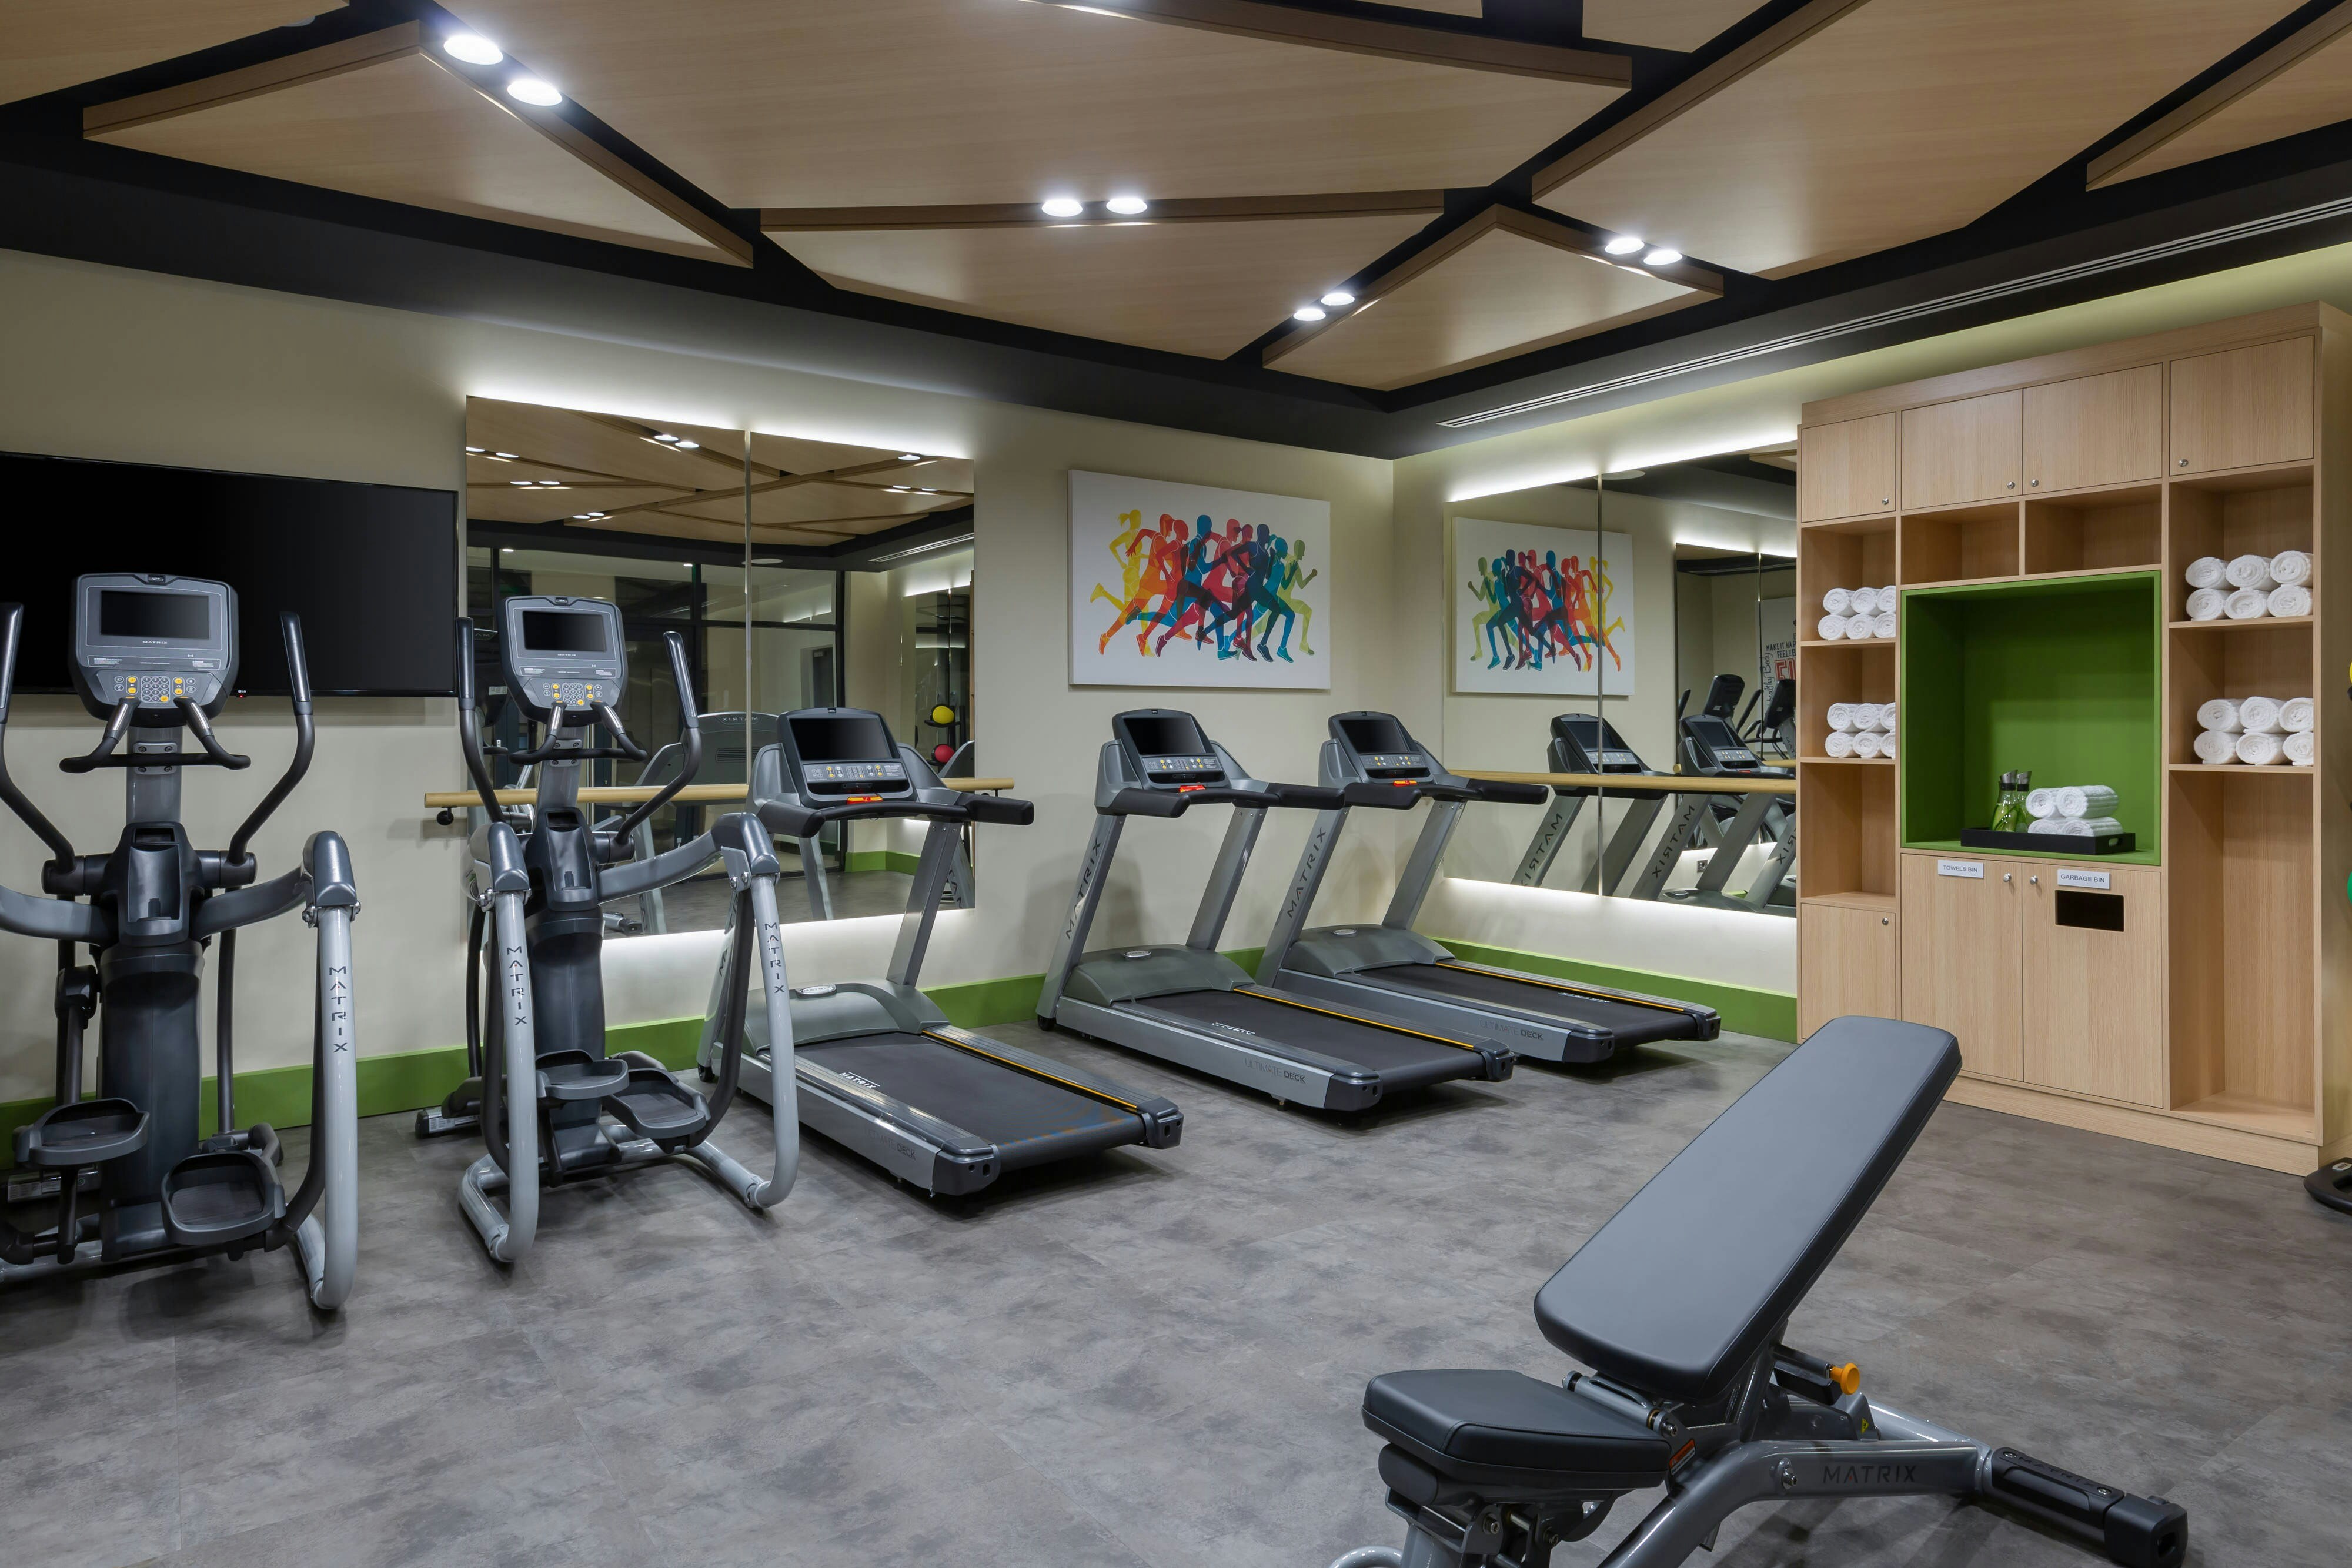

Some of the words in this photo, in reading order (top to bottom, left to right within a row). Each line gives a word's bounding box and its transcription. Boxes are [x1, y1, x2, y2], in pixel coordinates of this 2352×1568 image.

[1766, 643, 1779, 651] MAKE
[1777, 649, 1789, 659] FEEL
[1286, 827, 1326, 918] MATRIX
[2060, 874, 2092, 882] GARBAGE
[1065, 837, 1101, 940] MATRIX
[764, 922, 785, 994] MATRIX
[507, 945, 527, 1026] MATRIX
[329, 965, 348, 1054] MATRIX
[1479, 1018, 1519, 1035] ULTIMATE
[1521, 1029, 1544, 1041] DECK
[840, 1072, 876, 1089] MATRIX
[1244, 1058, 1282, 1078] ULTIMATE
[1284, 1071, 1306, 1084] DECK
[897, 1143, 916, 1161] DECK
[1823, 1465, 1917, 1484] MATRIX
[2019, 1456, 2098, 1489] MATRIX
